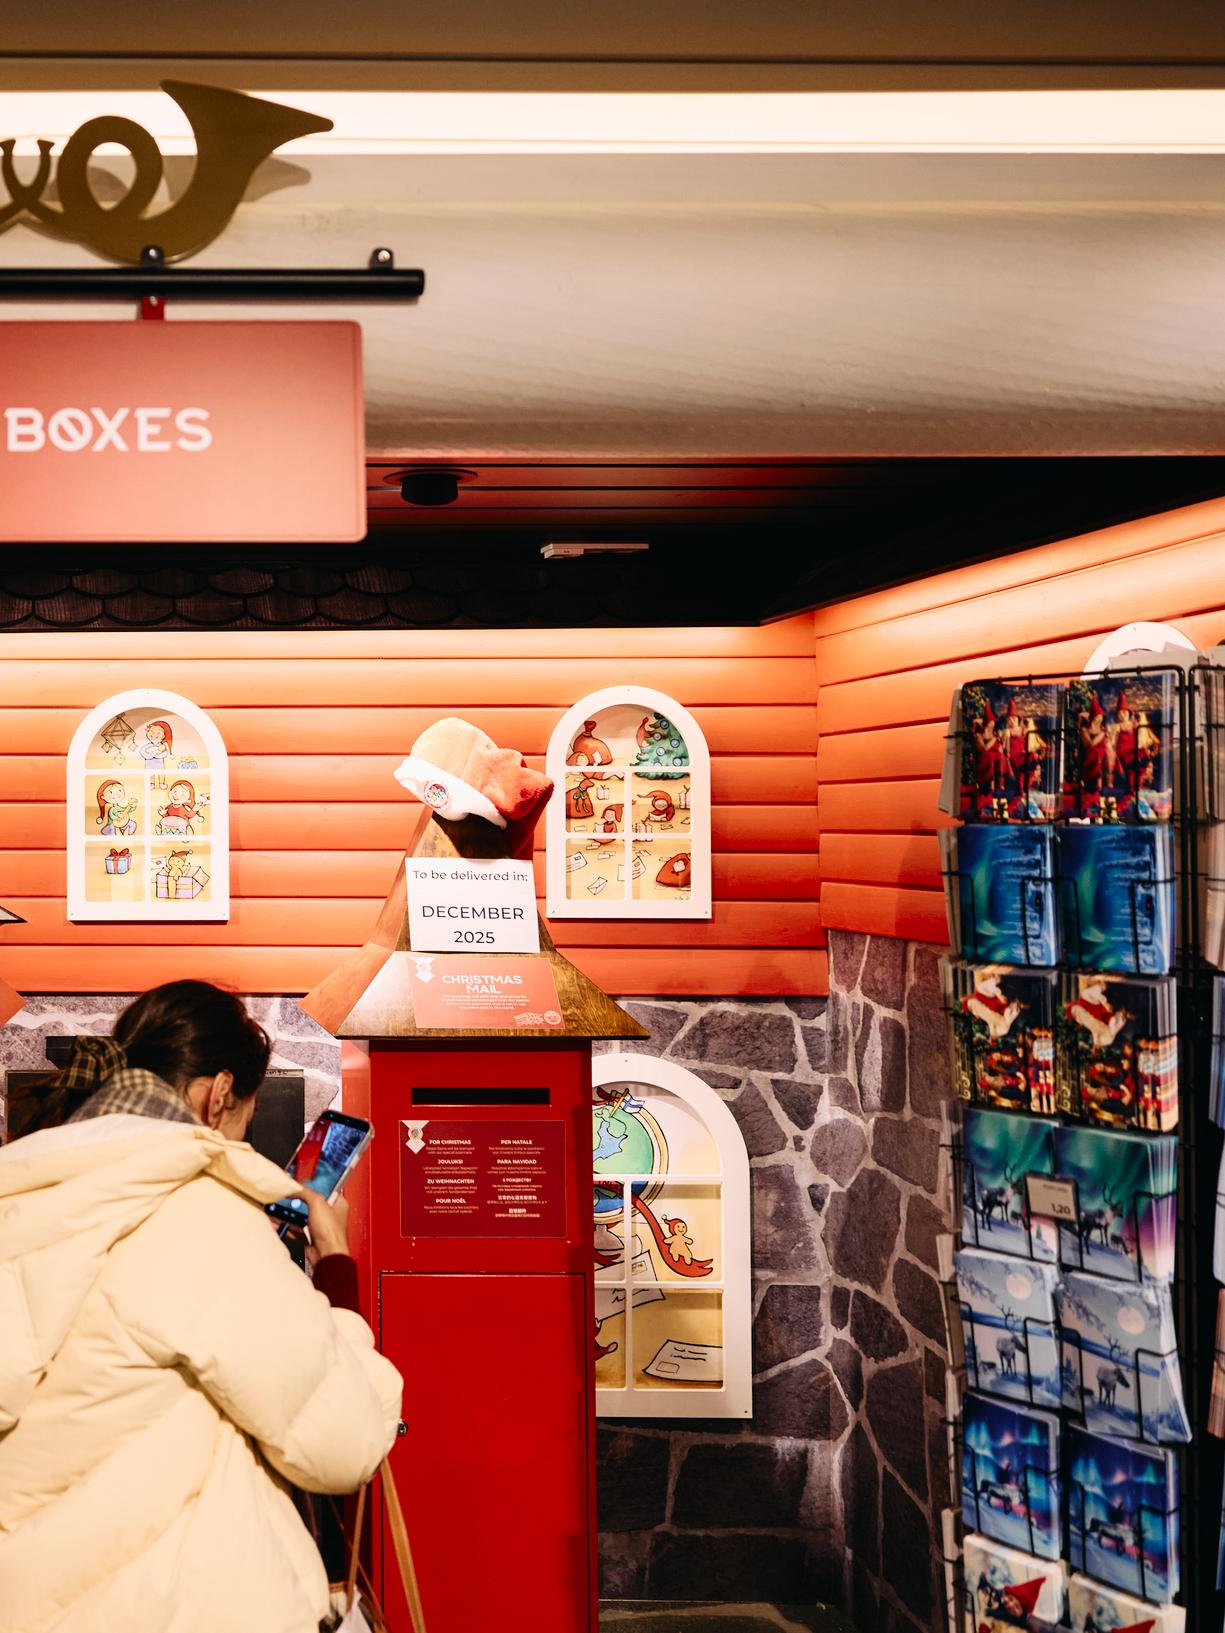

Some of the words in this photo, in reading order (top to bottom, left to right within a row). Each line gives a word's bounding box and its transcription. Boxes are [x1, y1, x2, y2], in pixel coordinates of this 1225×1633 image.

[4, 407, 213, 452] BOXES
[413, 870, 428, 880] To
[431, 870, 447, 880] be
[450, 870, 510, 881] delivered
[422, 905, 525, 920] DECEMBER
[454, 930, 496, 944] 2025
[441, 974, 523, 985] CHRISTMAS
[466, 984, 502, 994] MAIL
